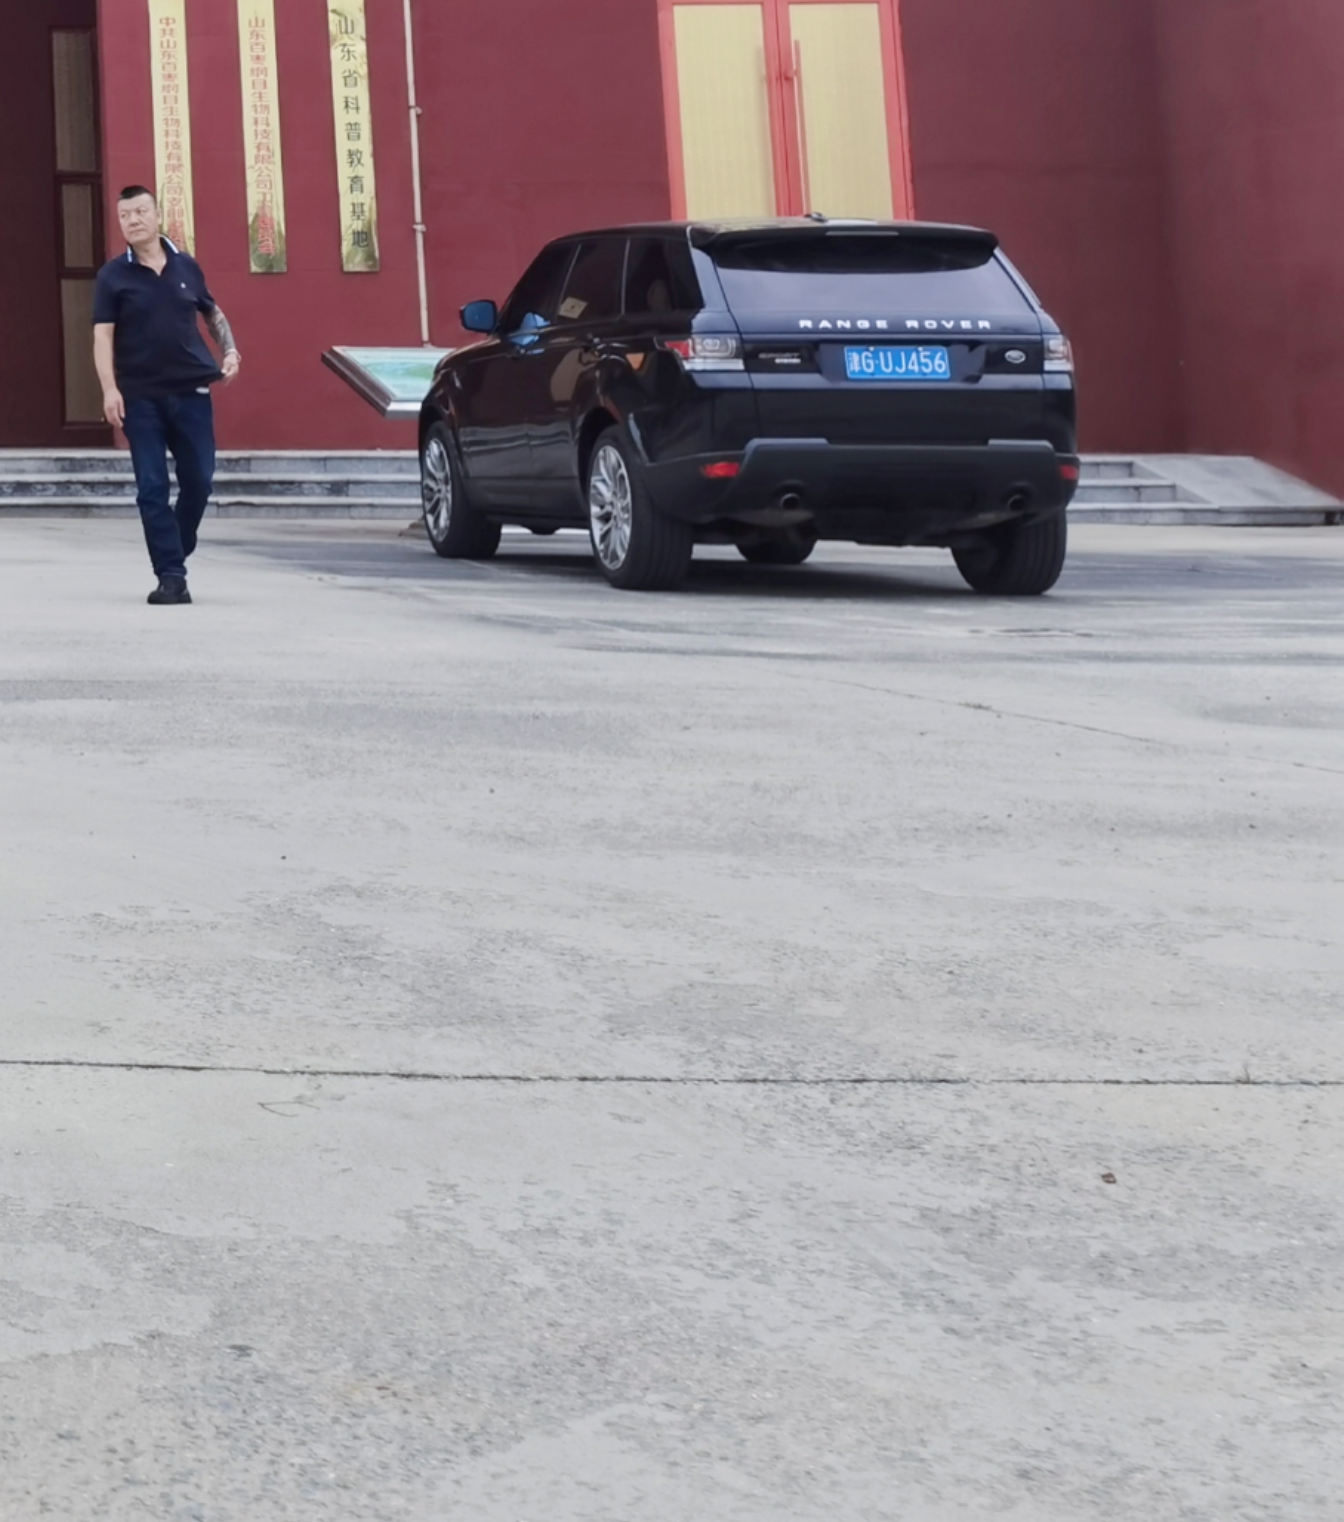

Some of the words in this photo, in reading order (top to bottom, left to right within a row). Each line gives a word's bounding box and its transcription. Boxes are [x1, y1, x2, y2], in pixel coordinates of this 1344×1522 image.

[337, 15, 369, 249] 山东省科普教育基地
[799, 319, 888, 329] RANGE
[905, 319, 991, 329] ROVER
